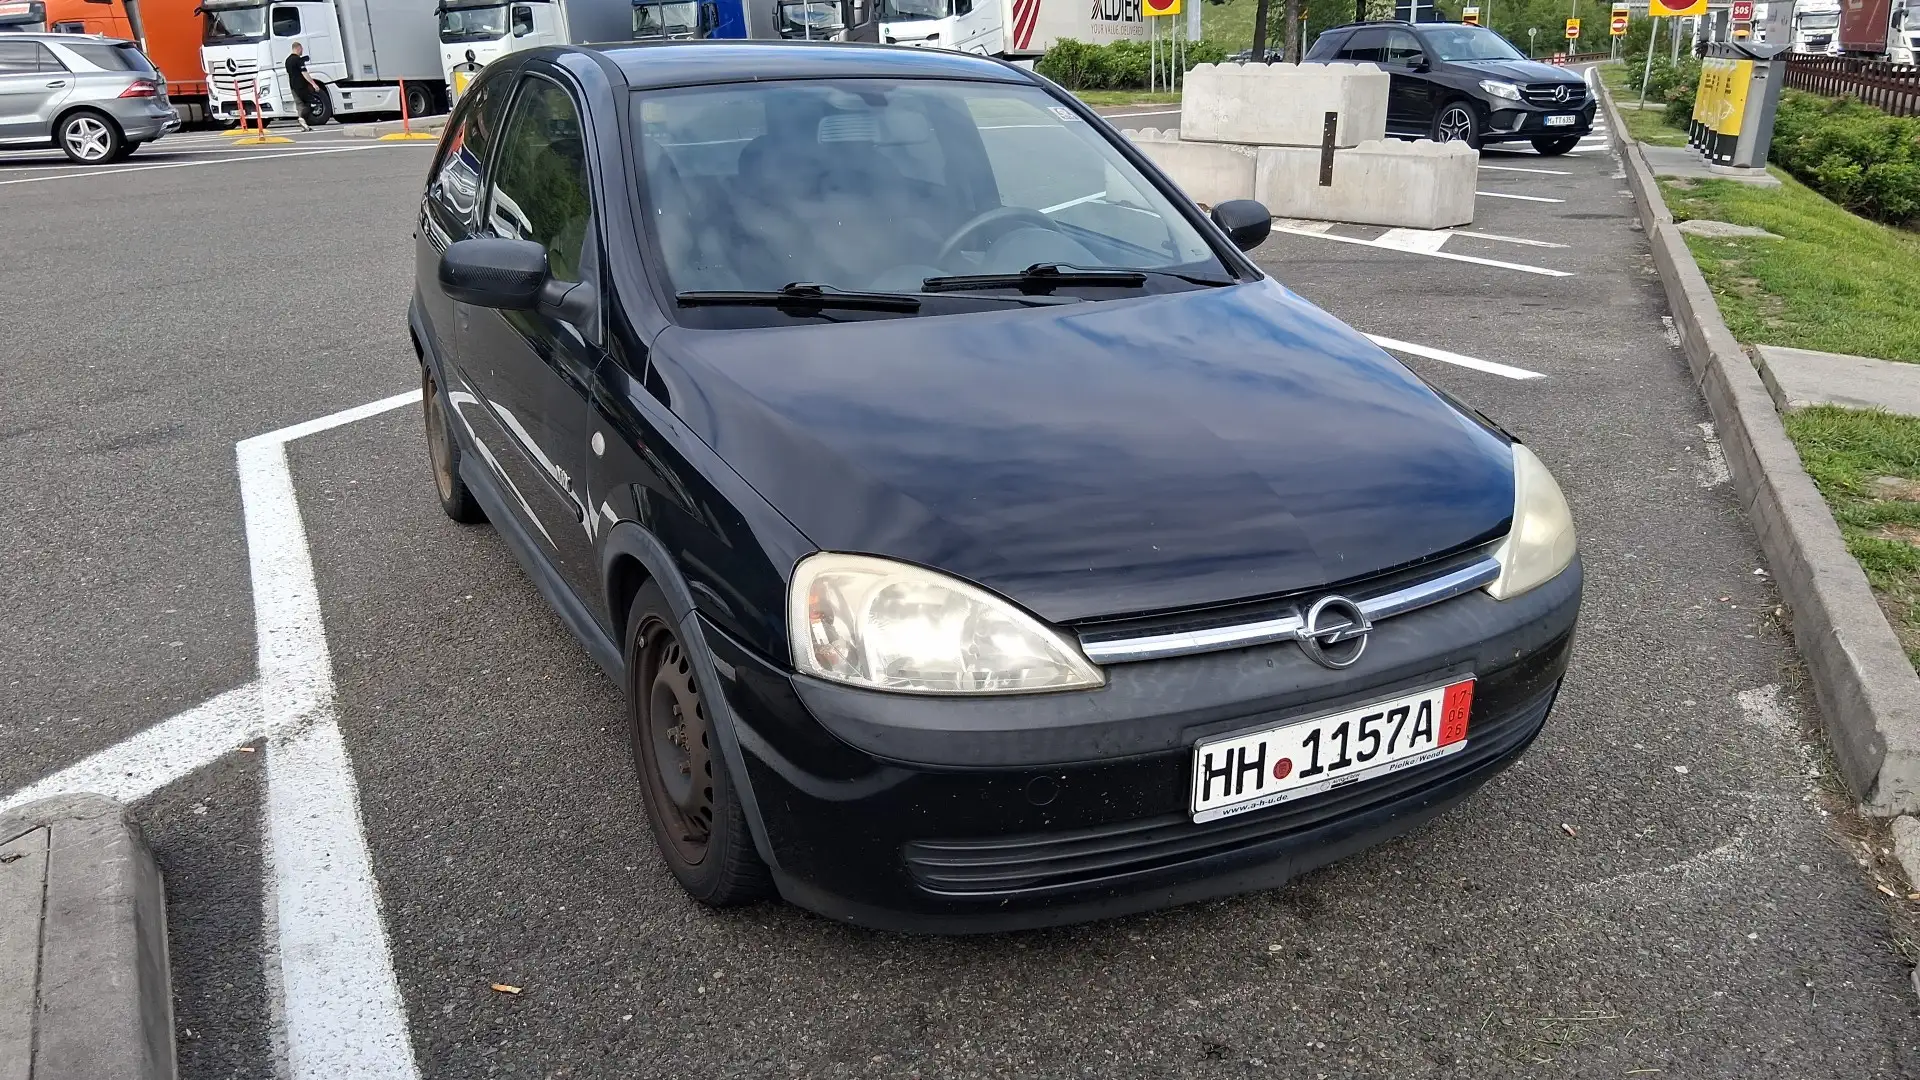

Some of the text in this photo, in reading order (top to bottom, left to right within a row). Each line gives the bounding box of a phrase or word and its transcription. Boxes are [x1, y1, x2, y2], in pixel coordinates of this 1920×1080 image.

[1734, 6, 1749, 15] SOS
[1091, 24, 1144, 36] YOUR VALUE DELIVERED
[1452, 689, 1468, 706] 17
[1448, 707, 1464, 723] 06
[1445, 724, 1462, 739] 26
[1202, 699, 1433, 802] HH 1157A
[1222, 794, 1289, 815] www.a-h-u.de
